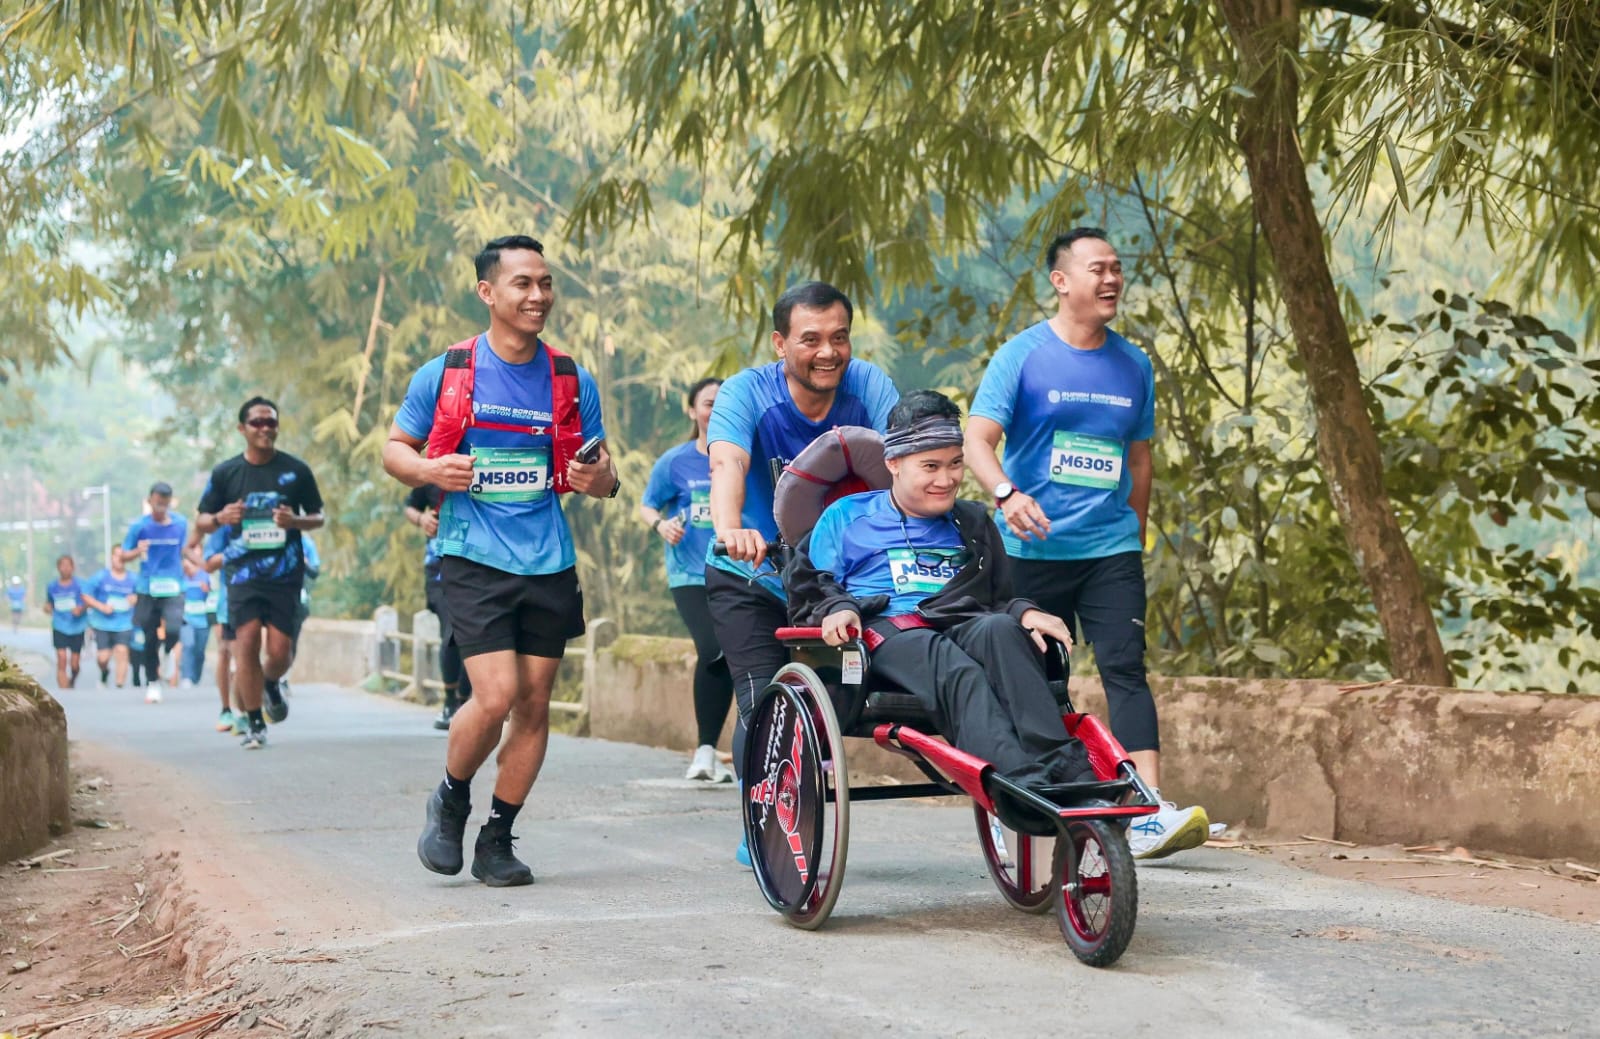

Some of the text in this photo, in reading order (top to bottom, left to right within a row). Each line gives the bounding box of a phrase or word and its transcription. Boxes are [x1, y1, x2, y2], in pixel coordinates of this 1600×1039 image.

[512, 408, 553, 419] BOROBUDU
[1060, 454, 1113, 472] M6305
[479, 471, 538, 485] M5805
[759, 695, 788, 831] MARATHON
